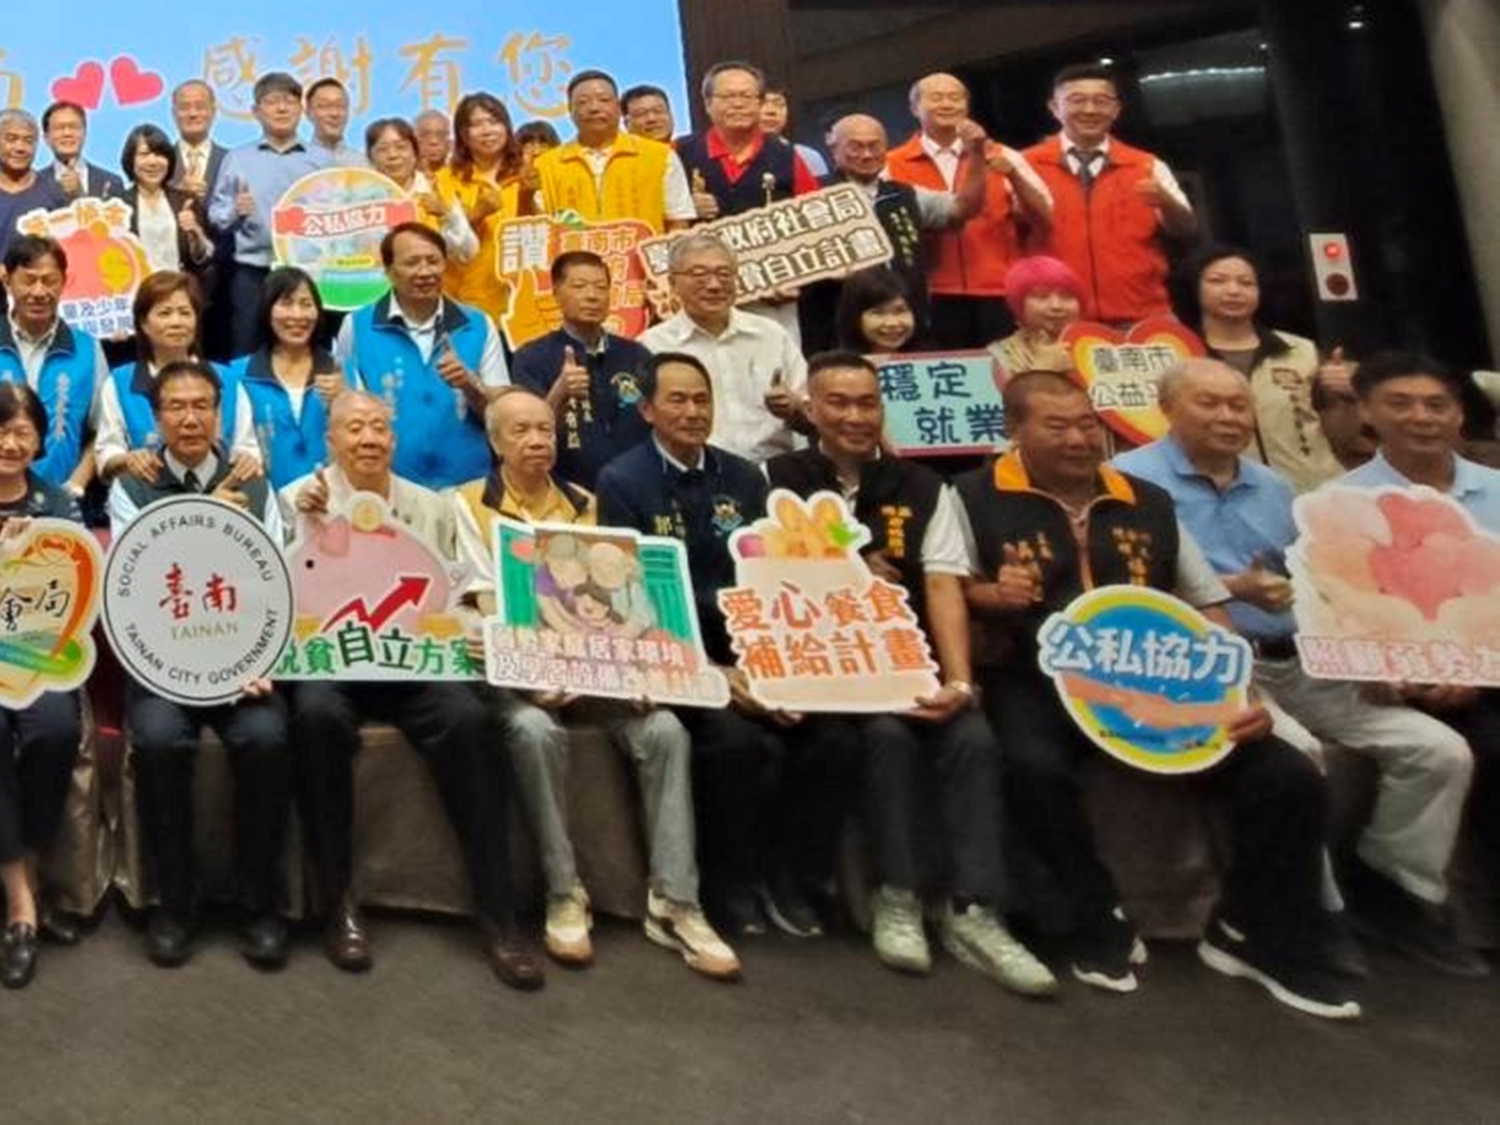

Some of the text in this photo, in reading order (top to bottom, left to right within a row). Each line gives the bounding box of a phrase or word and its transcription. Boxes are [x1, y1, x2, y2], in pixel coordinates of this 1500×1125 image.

[644, 190, 866, 274] 臺政府社會局
[736, 228, 886, 295] 貧自立計畫
[879, 361, 972, 402] 穩定
[914, 403, 1006, 445] 就業
[119, 515, 273, 597] SOCIAL AFFAIRS BUREAU
[159, 562, 237, 619] 臺南
[721, 580, 913, 632] 愛心餐食
[125, 609, 278, 685] TAINAN CITY GOVERNMENT
[171, 622, 238, 640] TAINAN
[740, 627, 933, 679] 補給計畫
[1048, 622, 1239, 684] 公私協力
